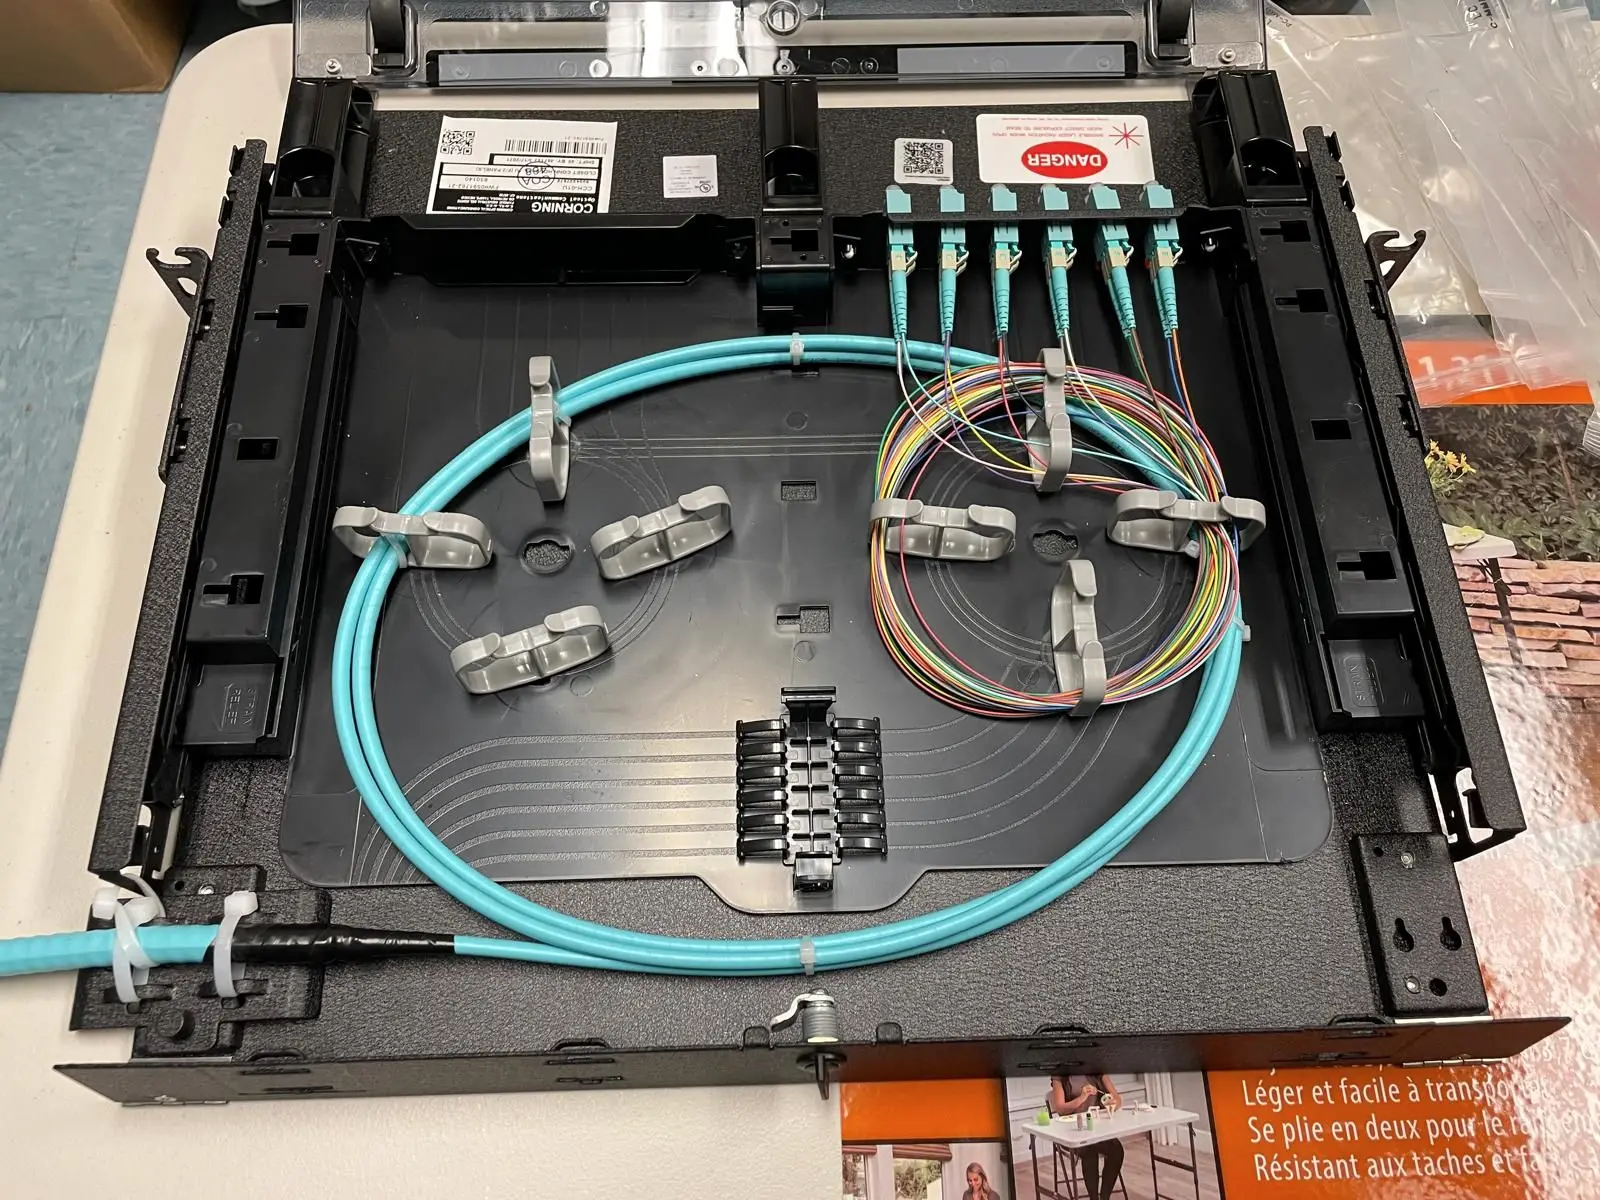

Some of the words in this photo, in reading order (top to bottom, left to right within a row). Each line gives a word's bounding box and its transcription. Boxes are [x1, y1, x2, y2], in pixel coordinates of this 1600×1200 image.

[1027, 153, 1102, 167] DANGER
[531, 201, 594, 214] CORNING
[1242, 1079, 1303, 1113] Léger
[1312, 1081, 1335, 1104] et
[1339, 1076, 1401, 1104] facile
[1406, 1076, 1420, 1102] à
[1248, 1116, 1275, 1143] Se
[1282, 1115, 1324, 1150] plie
[1331, 1120, 1359, 1142] en
[1366, 1113, 1421, 1141] deux
[1426, 1116, 1477, 1145] pour
[1482, 1108, 1505, 1137] le
[1254, 1153, 1361, 1181] Résistant
[1367, 1153, 1408, 1178] aux
[1411, 1148, 1486, 1177] taches
[1491, 1148, 1518, 1175] et
